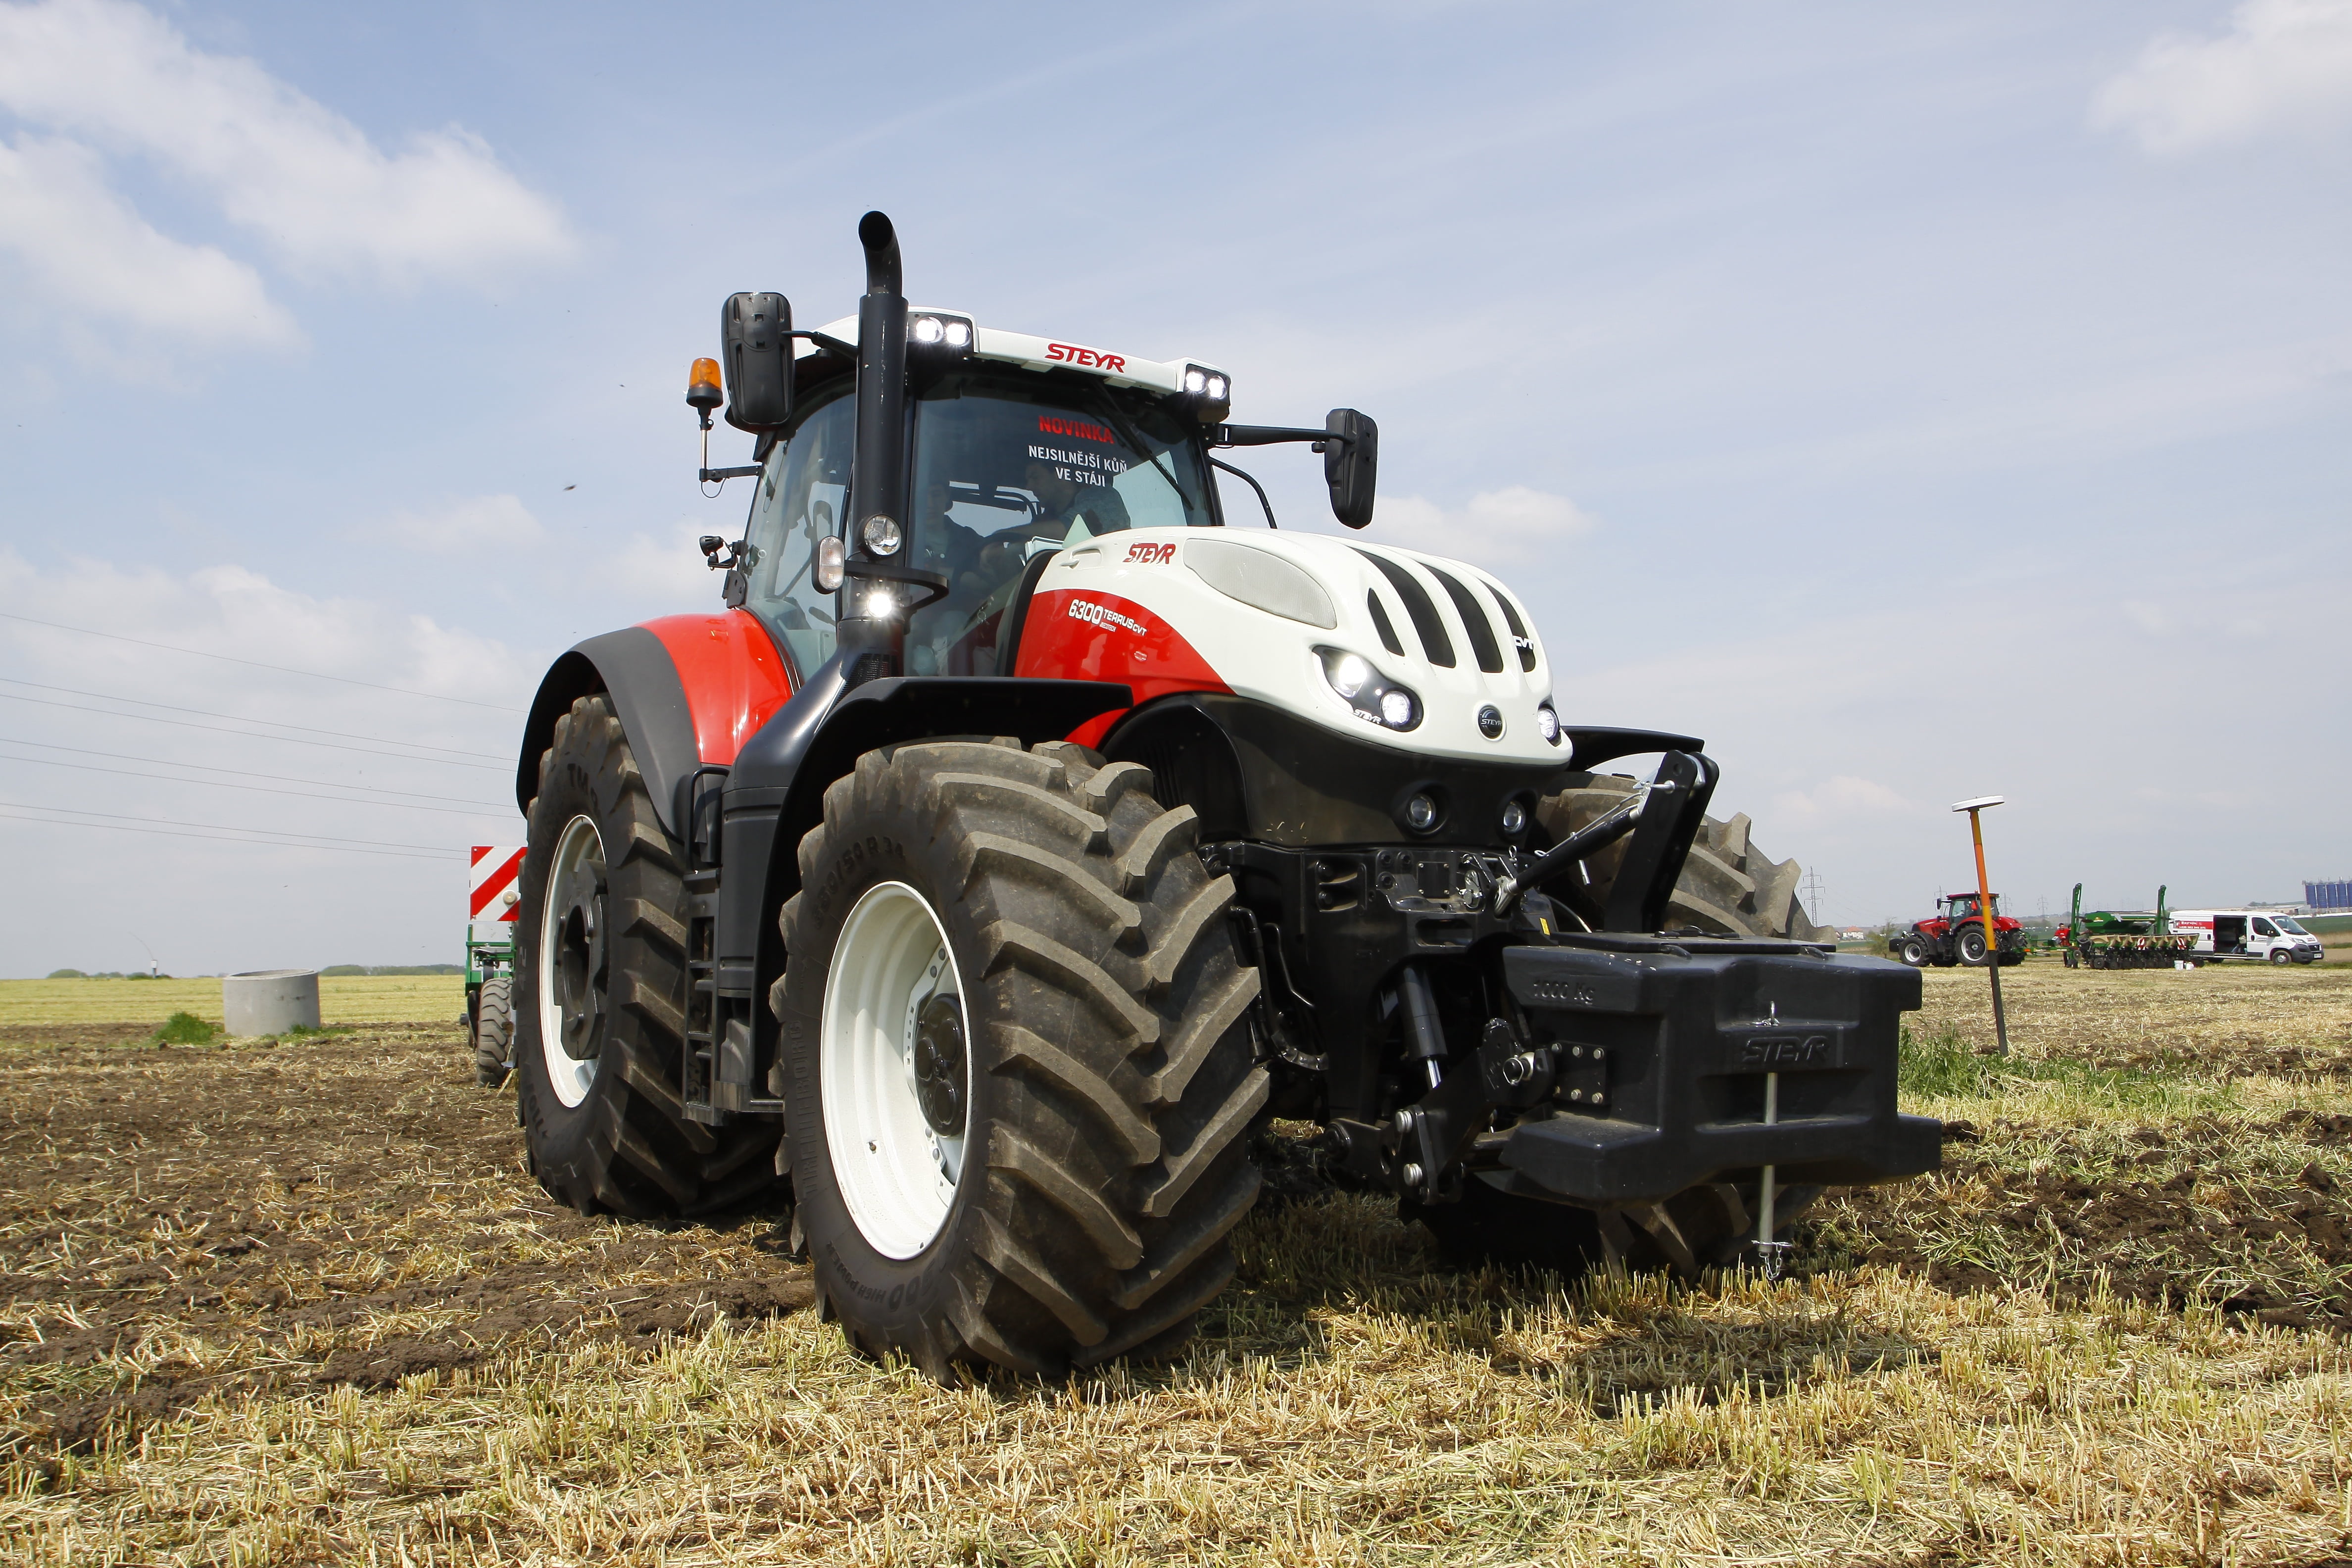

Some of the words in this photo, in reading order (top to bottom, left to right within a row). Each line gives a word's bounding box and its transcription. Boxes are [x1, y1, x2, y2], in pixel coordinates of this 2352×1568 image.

[1044, 343, 1125, 373] STEYR
[1038, 415, 1115, 444] NOVINKA
[1028, 444, 1100, 469] NEJSILNĚJŠÍ
[1104, 457, 1127, 474] KŮŇ
[1055, 467, 1072, 481] VE
[1075, 471, 1105, 488] STÁJI
[1122, 542, 1176, 564] STEYR
[1068, 599, 1104, 625] 6300
[1103, 608, 1135, 630] TERRUS
[1132, 624, 1148, 637] CVT
[1513, 635, 1533, 650] CVT
[1354, 709, 1382, 724] STEYR
[1533, 979, 1568, 999] 1000
[1741, 1036, 1830, 1063] STEYR
